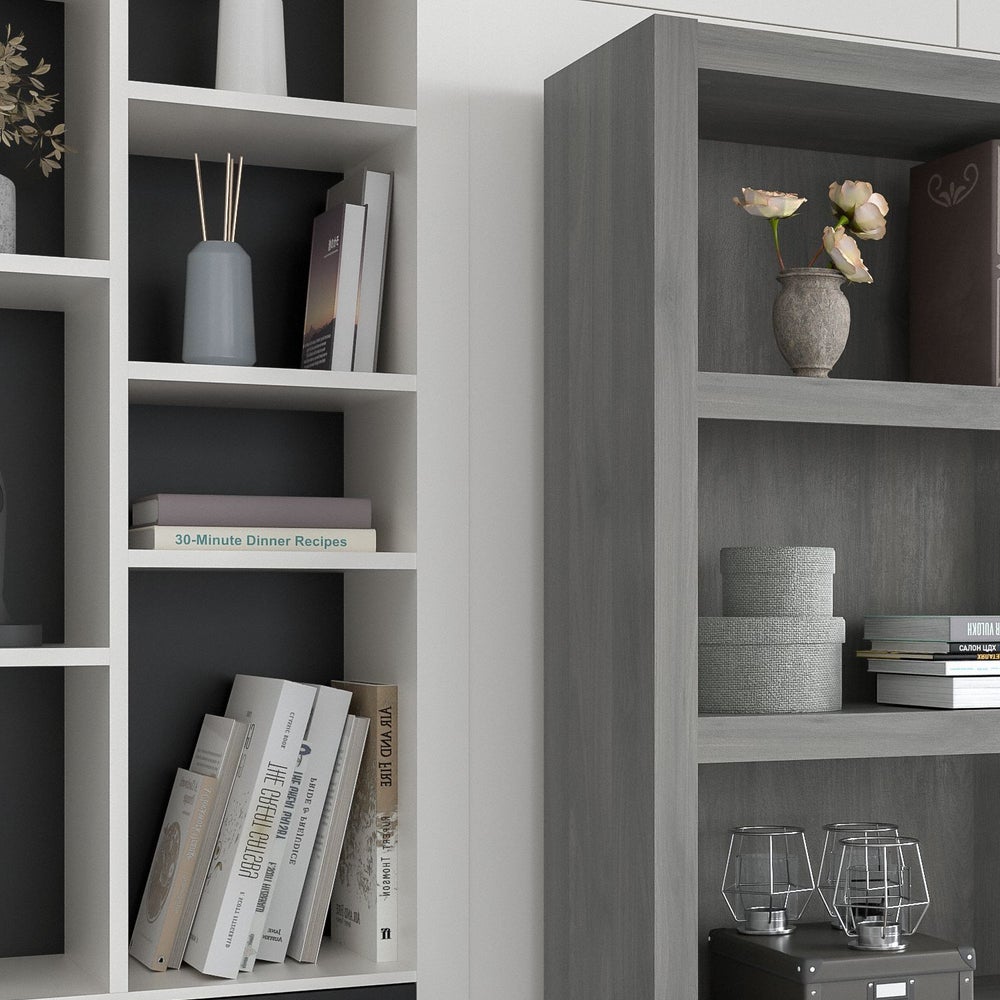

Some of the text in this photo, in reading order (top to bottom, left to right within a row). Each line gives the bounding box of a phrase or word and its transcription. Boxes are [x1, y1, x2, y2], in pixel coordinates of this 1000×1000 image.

[175, 533, 348, 550] 30-Minute Dinner Recipes
[967, 621, 995, 636] VULOKH
[959, 644, 981, 652] САЛОН
[982, 644, 997, 653] ЦДХ
